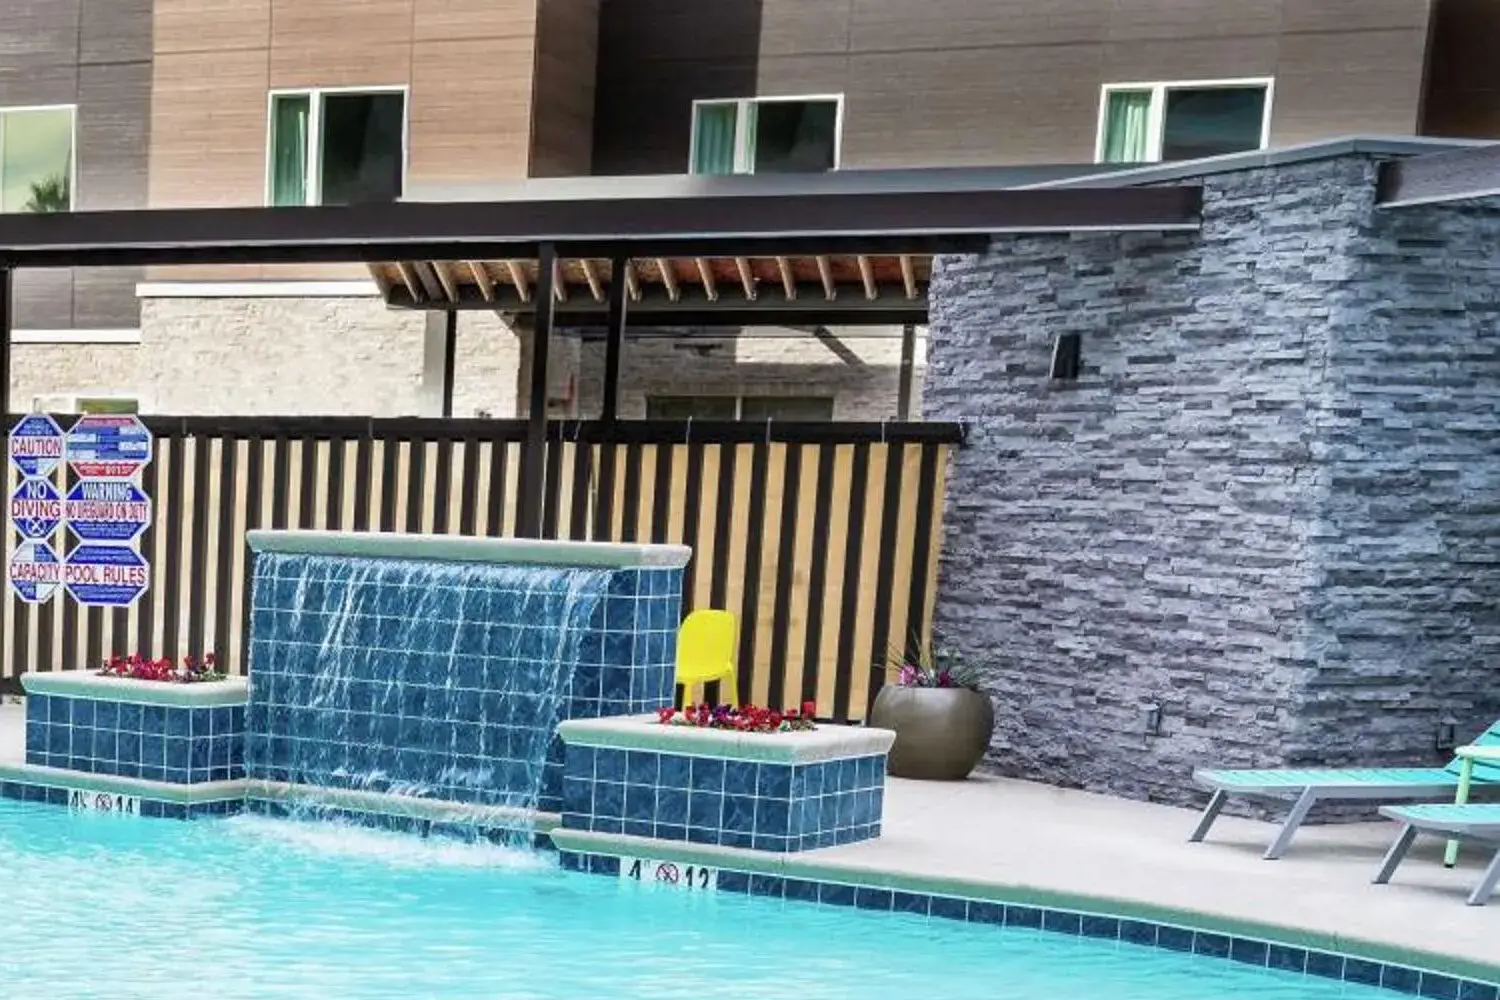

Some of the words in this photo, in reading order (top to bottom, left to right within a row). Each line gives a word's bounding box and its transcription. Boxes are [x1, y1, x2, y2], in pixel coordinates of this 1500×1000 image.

[12, 438, 61, 455] CAUTION
[28, 481, 47, 499] NO
[82, 482, 133, 500] WARNING
[12, 500, 60, 516] DIVING
[10, 563, 60, 580] CAPACITY
[66, 565, 99, 582] POOL
[104, 566, 145, 584] RULES
